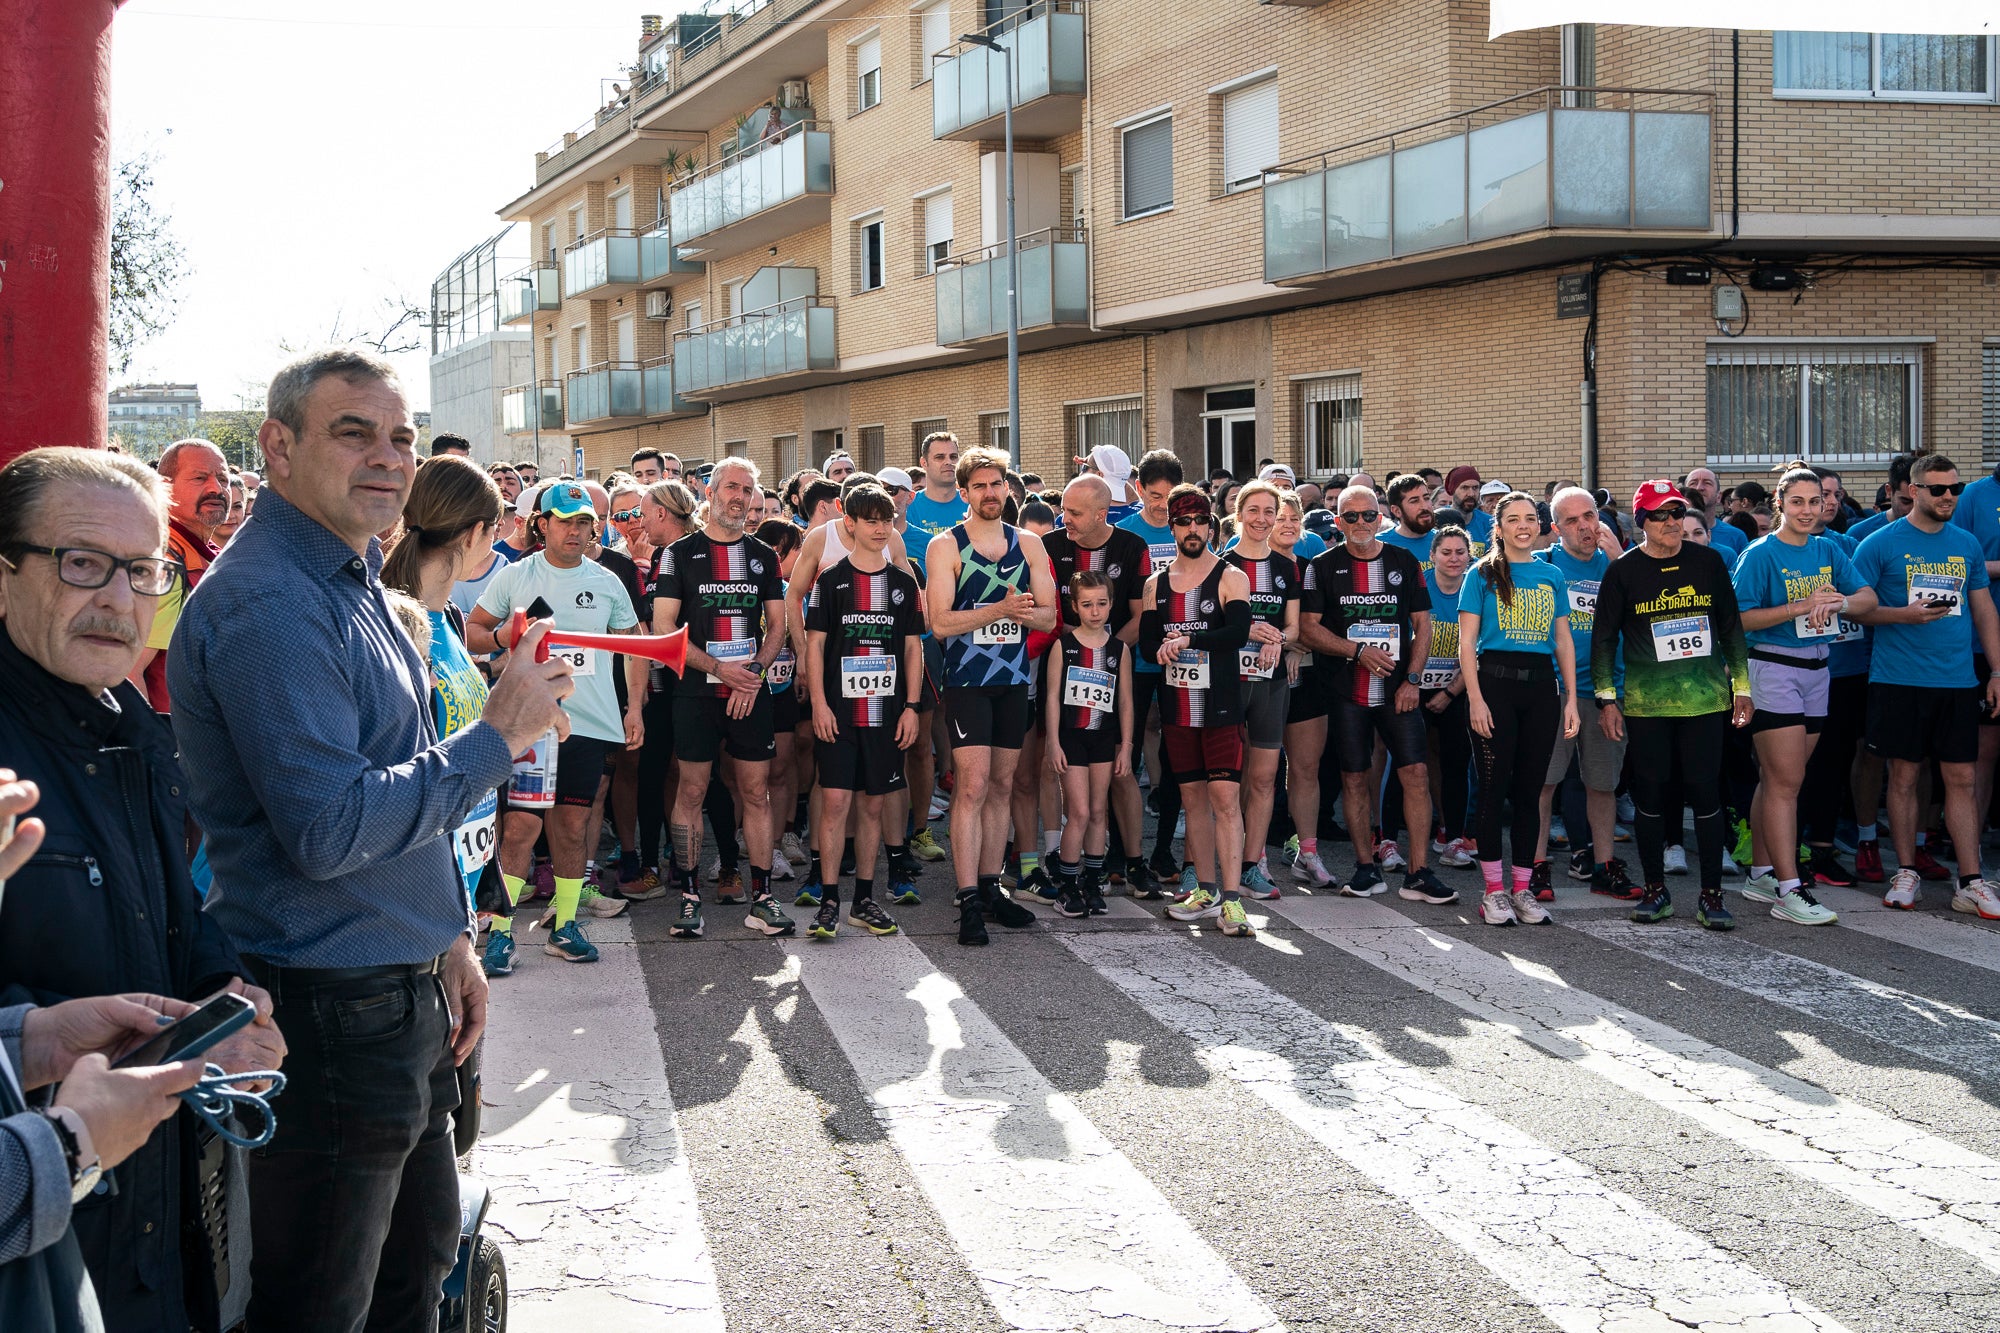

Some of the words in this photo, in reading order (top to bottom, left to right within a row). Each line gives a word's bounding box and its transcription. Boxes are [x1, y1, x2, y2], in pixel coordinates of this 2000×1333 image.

[1561, 293, 1587, 304] VOLUNTARIS
[699, 583, 759, 594] AUTOESCOLA
[700, 594, 758, 608] STILO
[1340, 595, 1398, 605] AUTOESCOLA
[1576, 596, 1596, 608] 64
[1635, 597, 1667, 615] VALLÈS
[1668, 595, 1692, 609] DRAC
[1693, 594, 1712, 607] RACE
[1251, 603, 1281, 614] ILO
[1343, 604, 1398, 617] STILO
[980, 622, 1019, 637] 1089
[1667, 635, 1703, 651] 186
[1171, 666, 1200, 681] 376
[1423, 673, 1454, 684] 872
[848, 675, 892, 690] 1018
[1071, 684, 1112, 704] 1133
